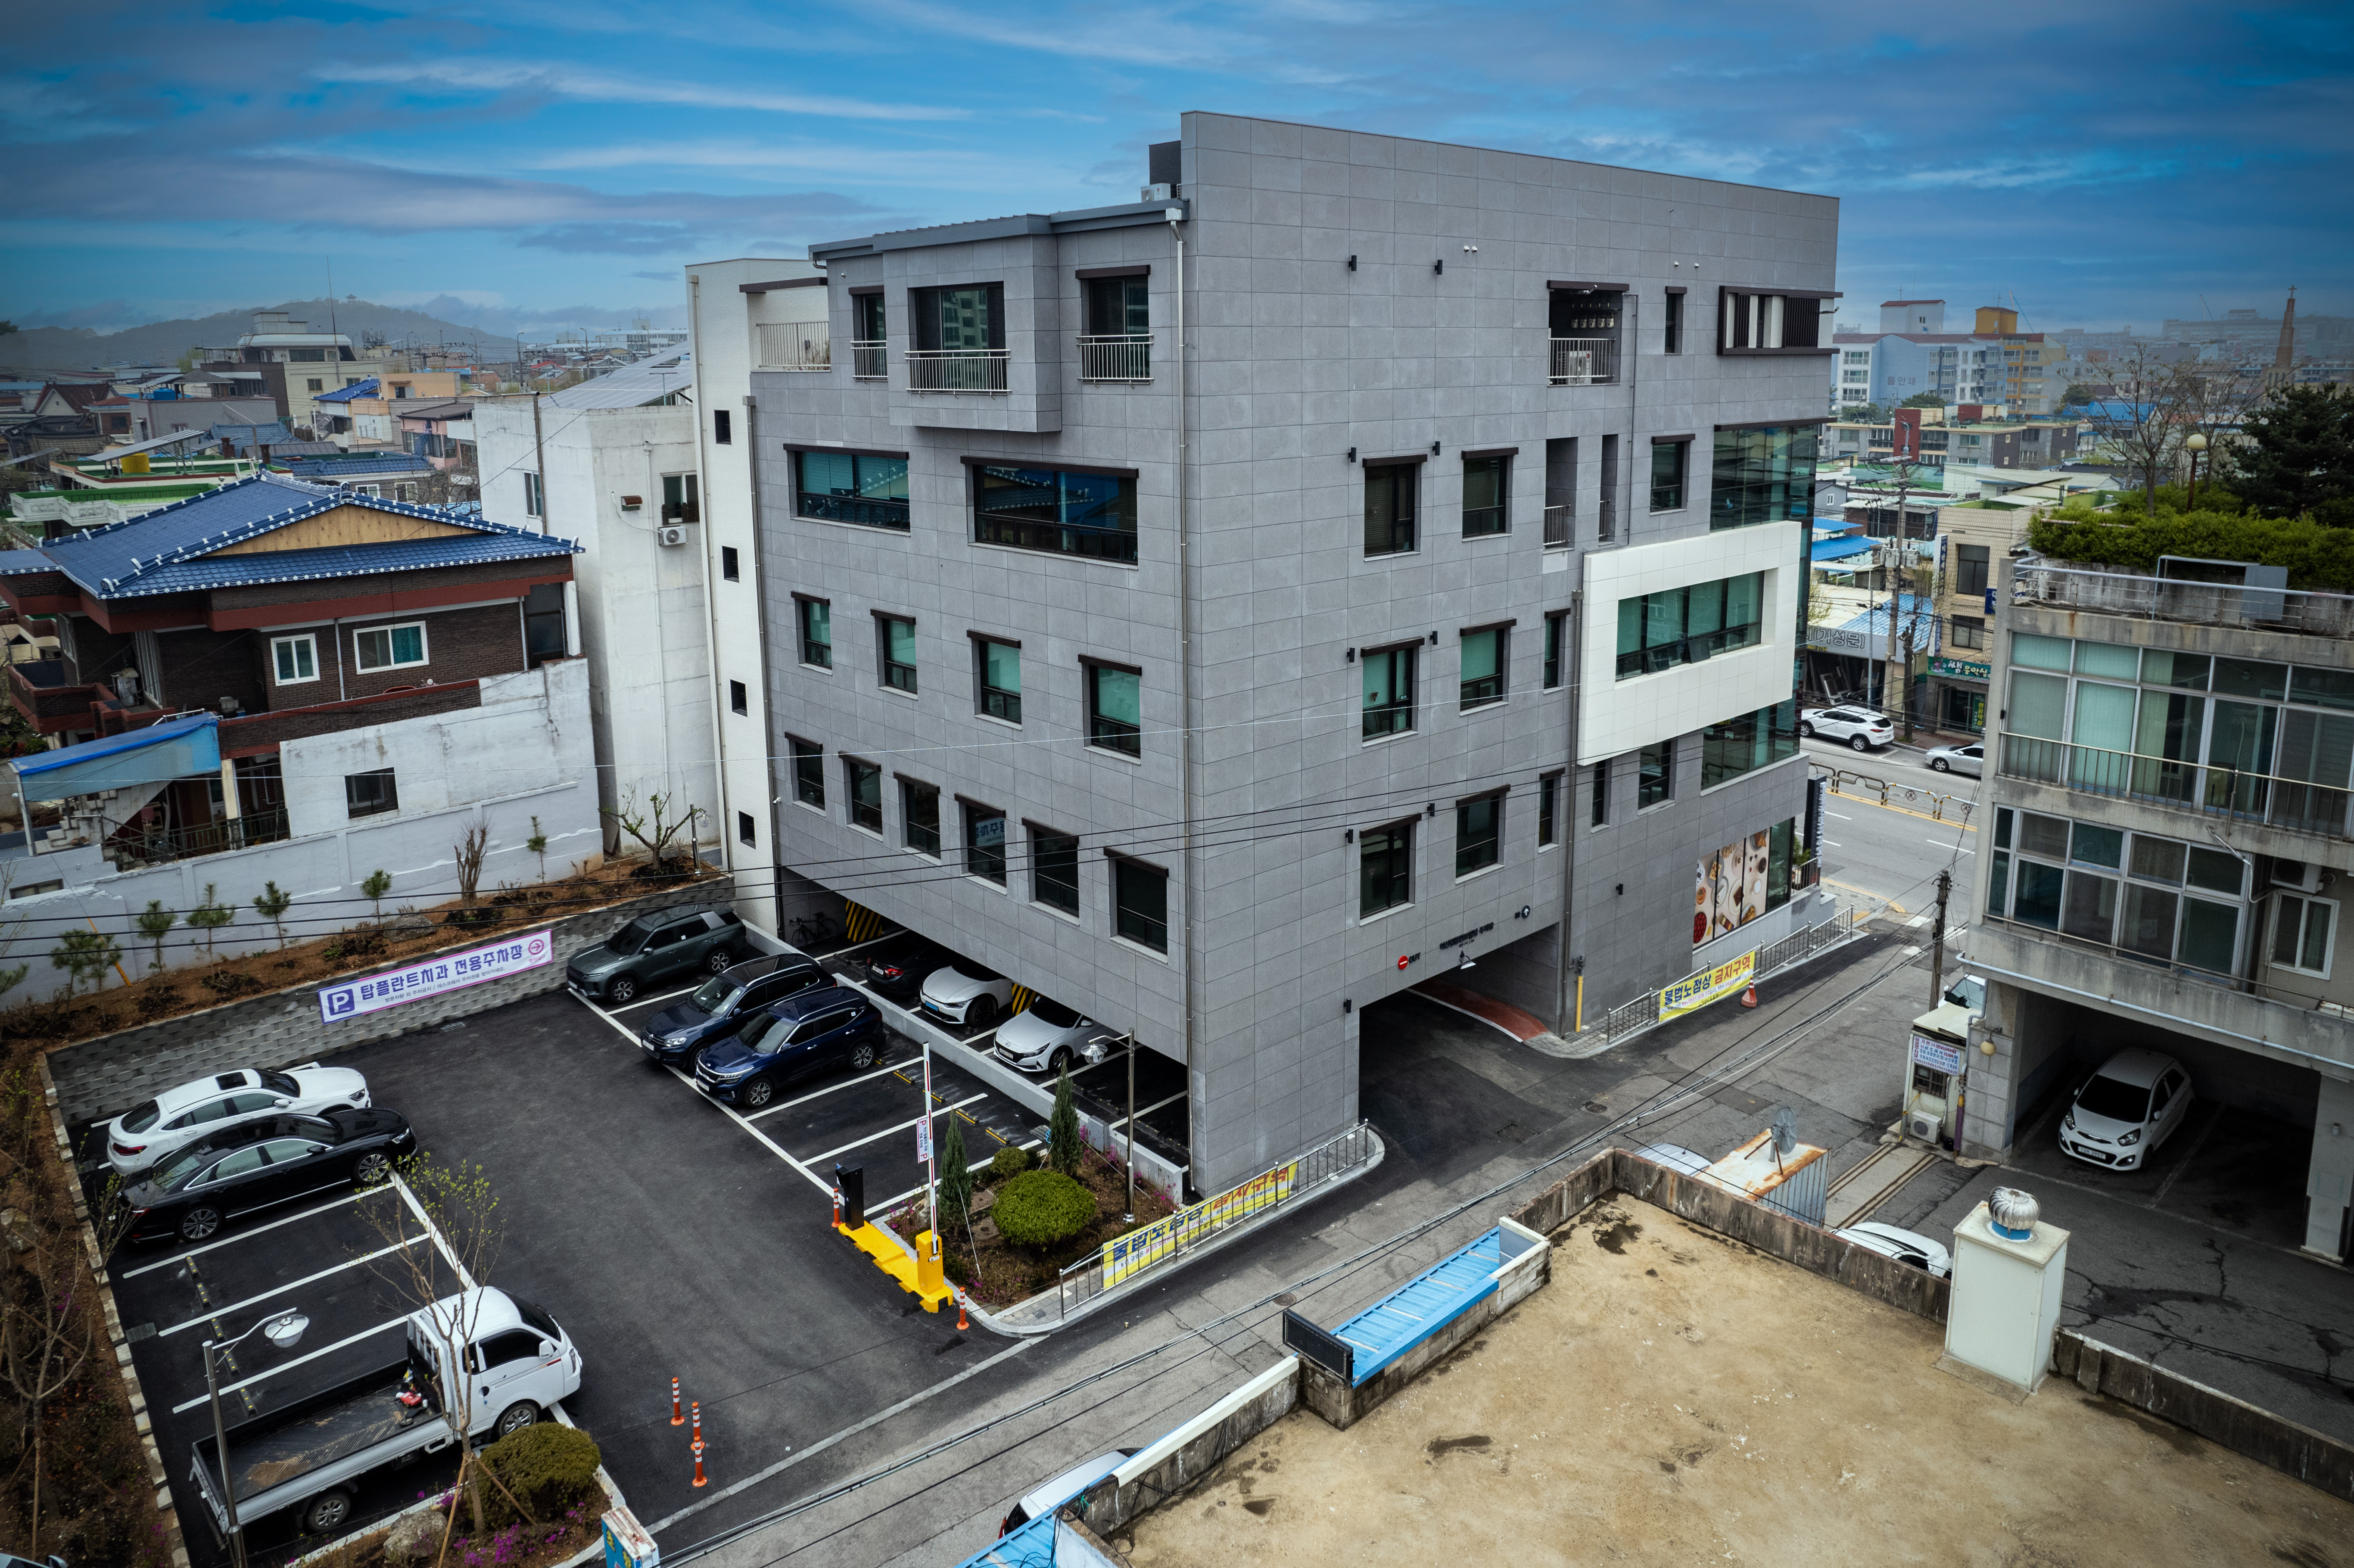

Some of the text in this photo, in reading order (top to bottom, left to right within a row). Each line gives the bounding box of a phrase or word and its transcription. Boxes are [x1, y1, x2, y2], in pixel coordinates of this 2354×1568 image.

[1948, 660, 1962, 674] 쌤
[1515, 911, 1521, 919] IN
[1408, 952, 1421, 963] OUT
[361, 944, 523, 1001] 탑플란트치과 전용주차장
[1665, 955, 1751, 1006] 불법노점상 금지구역
[385, 993, 405, 1003] 방문차량
[412, 986, 432, 995] 주차금지
[437, 979, 461, 989] 데스크에서
[461, 974, 480, 982] 주차권을
[1114, 1167, 1288, 1262] 불법노점상 금지구역
